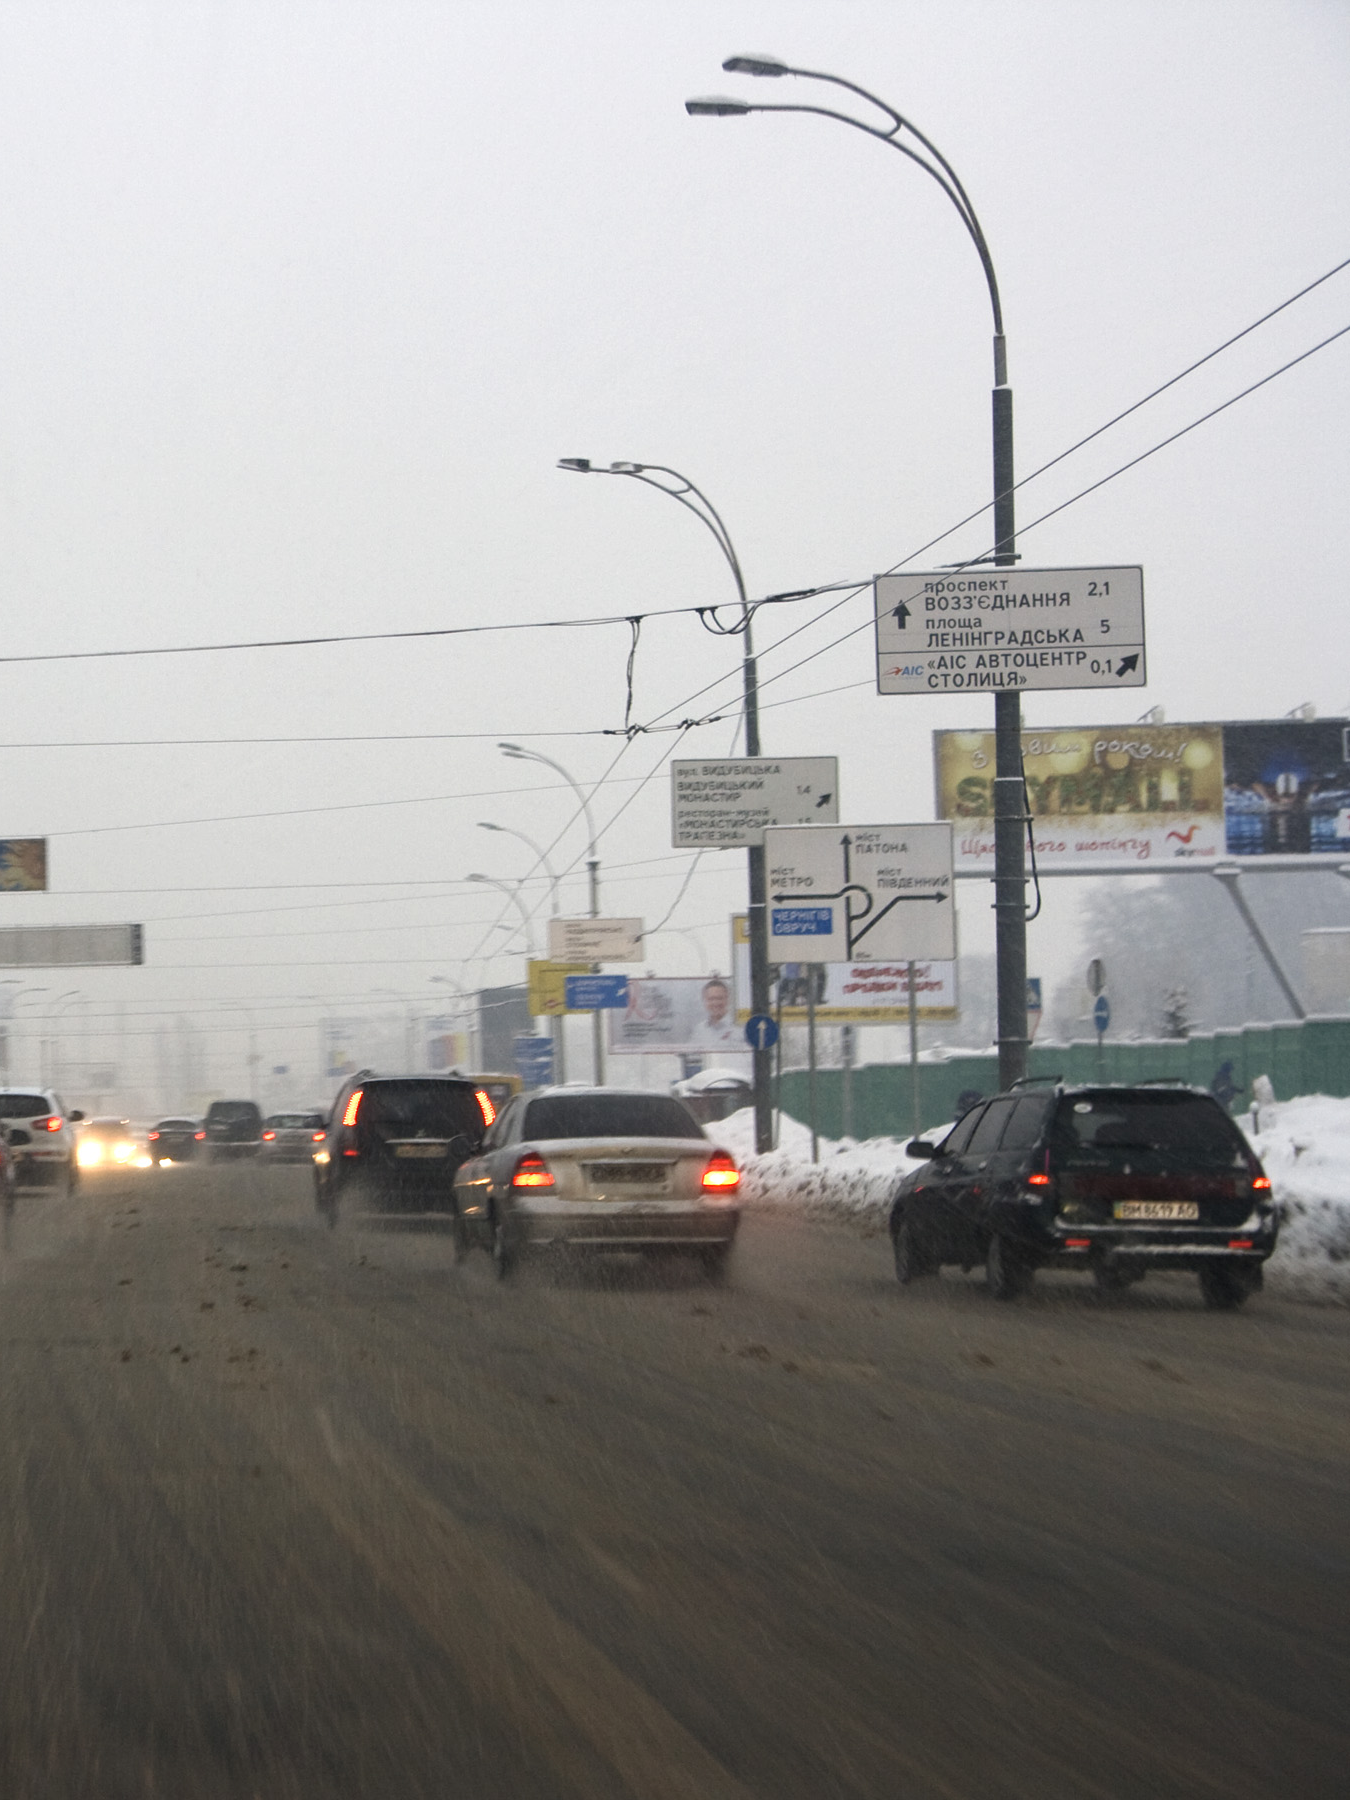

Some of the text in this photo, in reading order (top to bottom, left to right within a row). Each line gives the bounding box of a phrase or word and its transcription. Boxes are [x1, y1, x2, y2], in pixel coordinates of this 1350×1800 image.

[924, 579, 1111, 598] проспект 2,1
[925, 615, 1111, 634] площа 5
[927, 629, 1084, 648] ЛЕНІНГРАДСЬКА
[975, 651, 1087, 669] АВТОЦЕНТР
[1090, 659, 1112, 675] 0,1
[927, 672, 1027, 688] СТОЛИЦЯ»
[702, 765, 781, 777] ВИДУБИЦЬКА
[677, 778, 765, 791] ВИДУБИЦЬКИЙ
[677, 792, 742, 802] МОНАСТИР
[855, 833, 881, 842] міст
[855, 843, 908, 854] ПАТОНА
[770, 867, 796, 876] міст
[877, 867, 902, 876] міст
[770, 877, 814, 888] МЕТРО
[877, 874, 950, 889] ПІВДЕННИЙ
[773, 910, 830, 922] ЧЕРНІГІВ
[774, 922, 817, 933] ОВРУЧ
